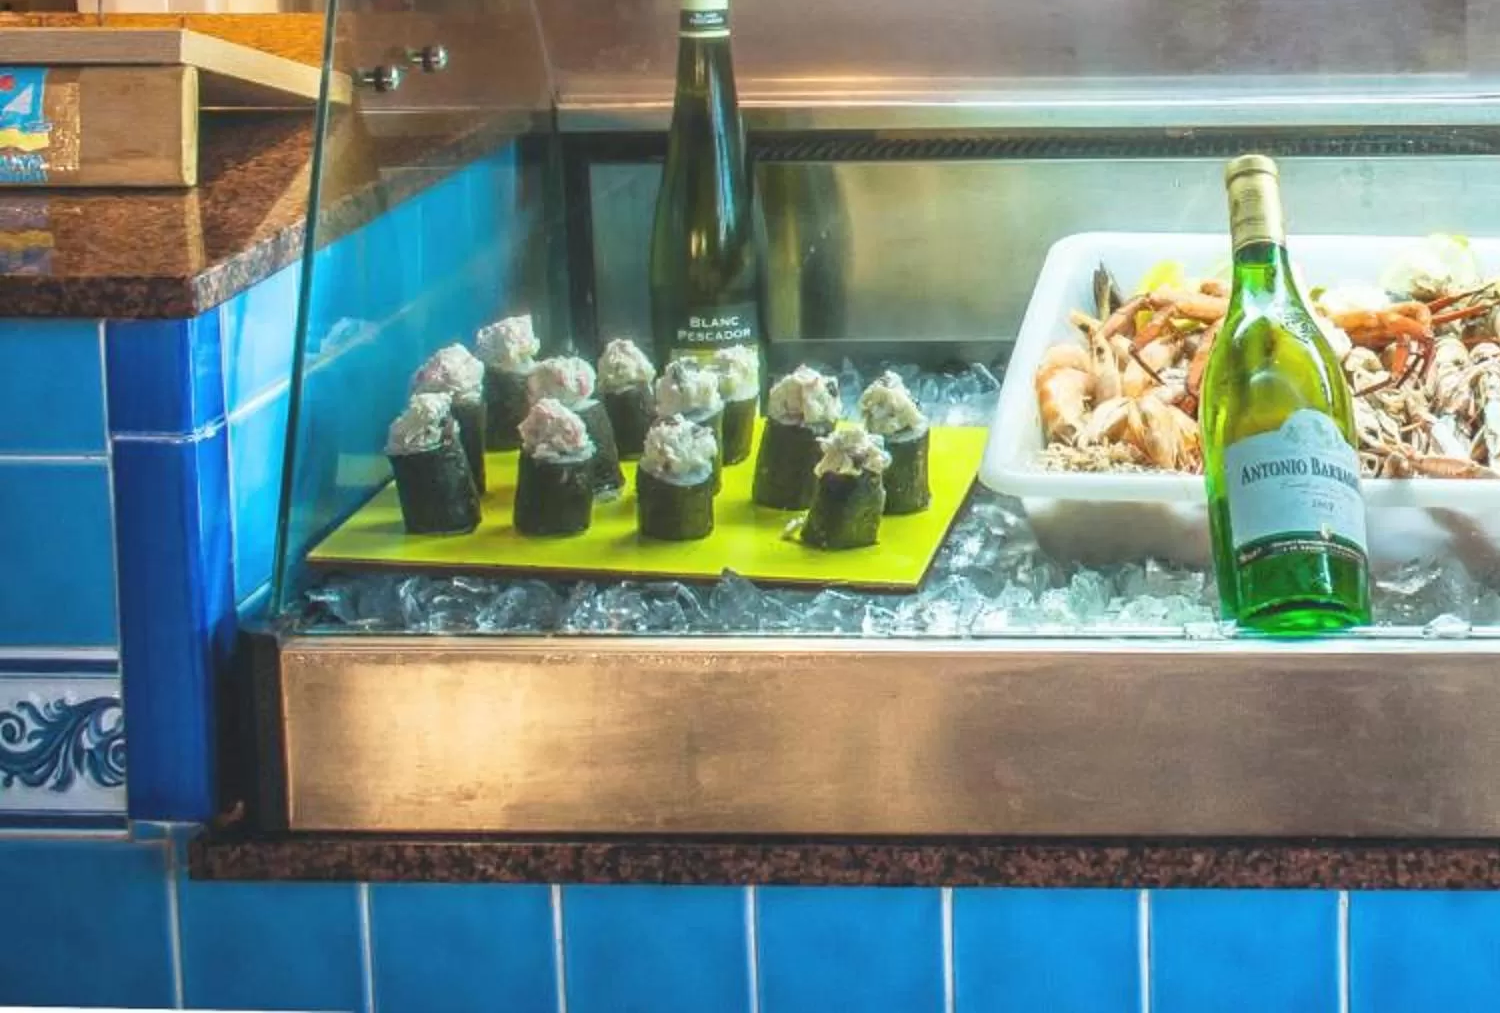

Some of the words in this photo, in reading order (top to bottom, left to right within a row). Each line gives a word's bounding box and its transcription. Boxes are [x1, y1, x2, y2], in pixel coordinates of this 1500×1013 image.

[689, 315, 740, 329] BLANC
[676, 327, 752, 342] PESCADOR
[1241, 457, 1308, 486] ANTONIO
